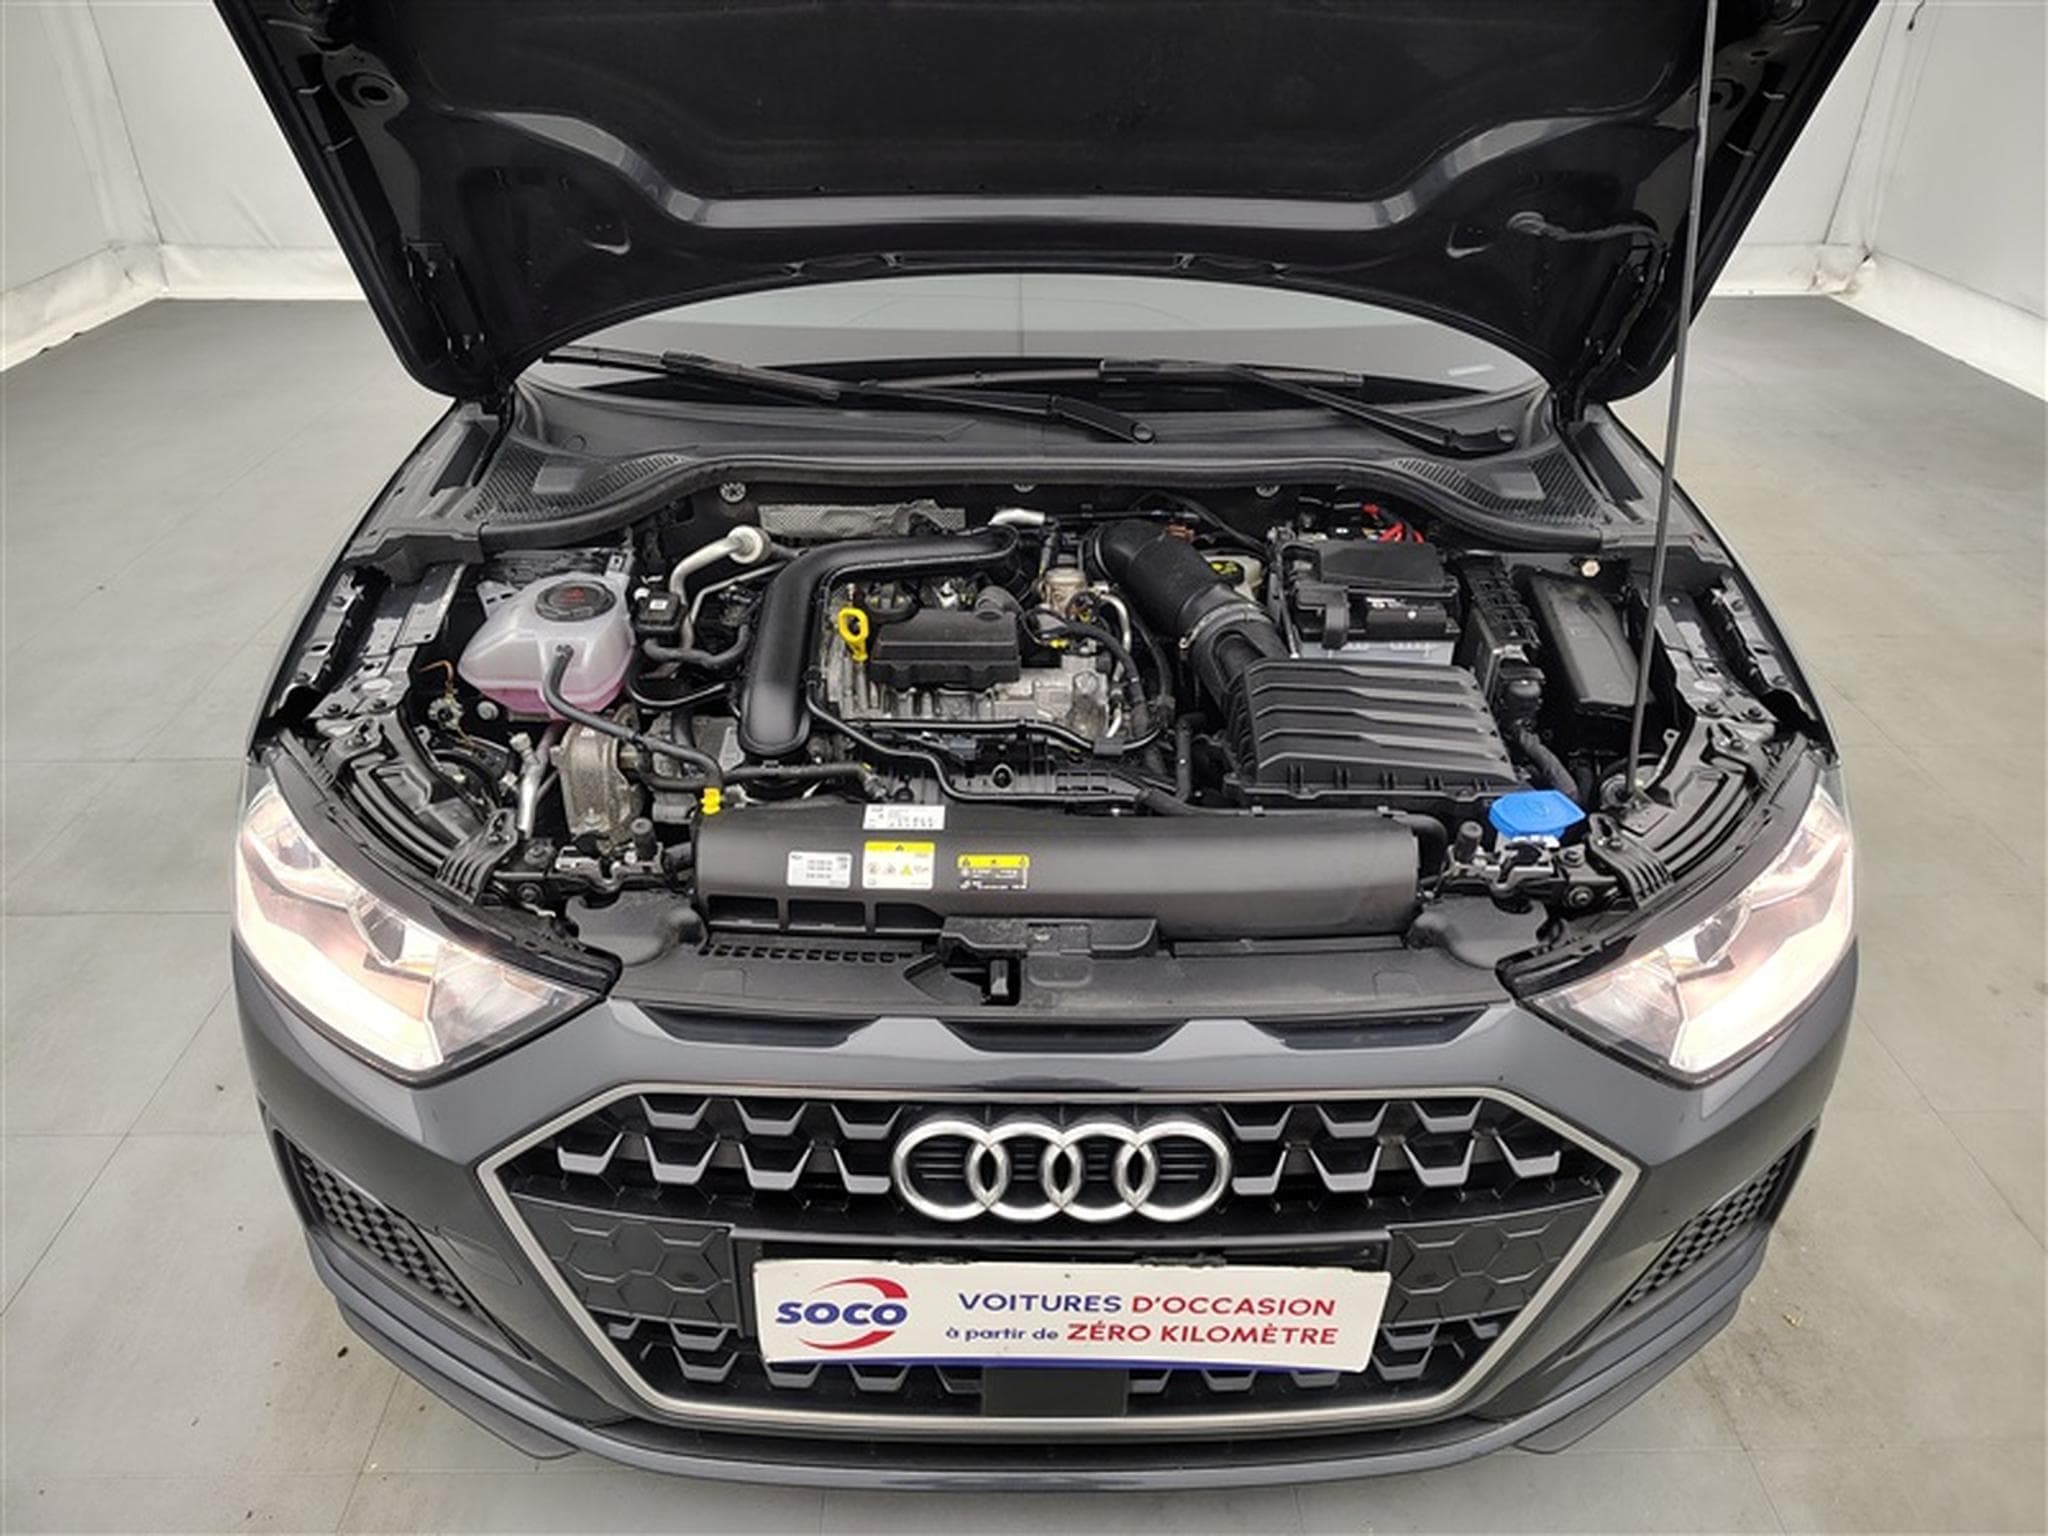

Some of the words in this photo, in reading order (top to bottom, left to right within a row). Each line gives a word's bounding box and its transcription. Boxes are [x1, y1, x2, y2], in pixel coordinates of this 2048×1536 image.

[776, 1301, 908, 1326] SOCO
[957, 1293, 1123, 1313] VOITURES
[1131, 1295, 1336, 1316] D'OCCASION
[945, 1326, 960, 1340] à
[965, 1327, 1026, 1342] partir
[1032, 1327, 1059, 1340] de
[1067, 1320, 1152, 1342] ZÉRO
[1160, 1323, 1339, 1345] KILOMÈTRE
